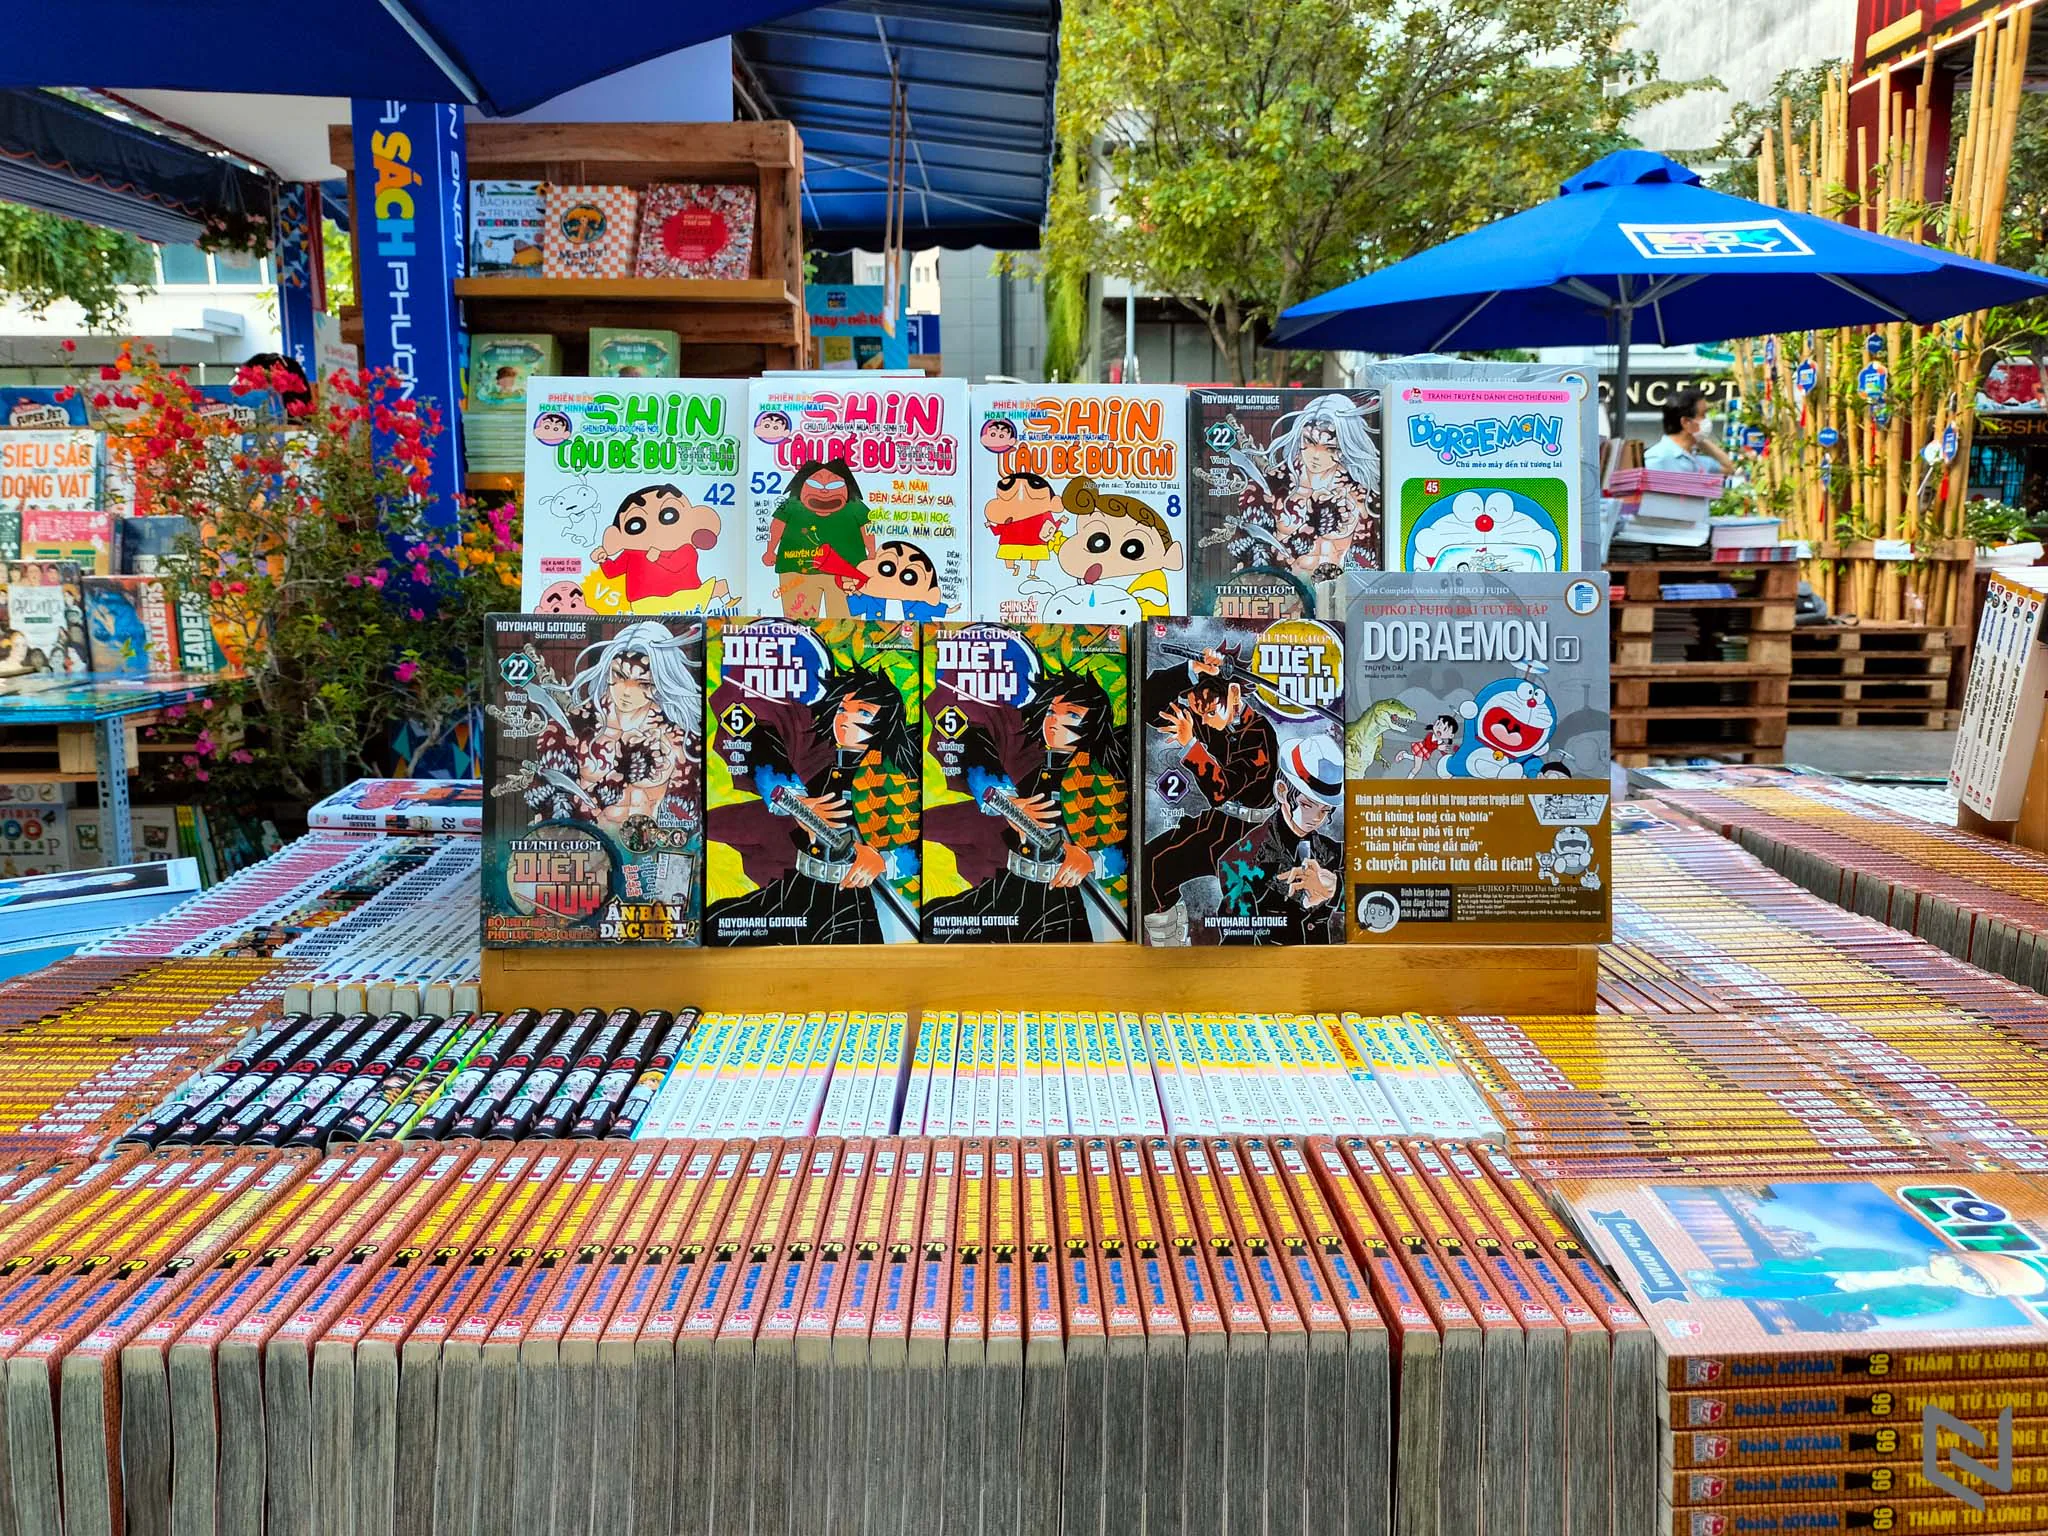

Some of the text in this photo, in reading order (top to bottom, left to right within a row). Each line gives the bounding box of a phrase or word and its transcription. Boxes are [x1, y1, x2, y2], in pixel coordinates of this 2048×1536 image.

[371, 130, 422, 256] SÁCH
[1428, 392, 1452, 400] TRANH
[1212, 427, 1231, 447] 22
[1086, 443, 1133, 475] BÚT
[1137, 443, 1174, 475] CHÌ
[750, 471, 782, 495] 52
[1124, 480, 1180, 490] Yoshito Usui
[1426, 481, 1439, 493] 45
[703, 483, 736, 506] 42
[1166, 494, 1182, 518] 8
[594, 583, 621, 607] VS
[1364, 604, 1407, 616] FUJIKO
[1410, 605, 1417, 615] F
[179, 591, 208, 672] EADERS
[496, 621, 587, 632] KOYOHARU GOTOUGE
[1363, 620, 1548, 661] DORAEMON
[508, 659, 529, 681] 22
[730, 709, 744, 731] 5
[944, 712, 957, 733] 5
[1167, 775, 1179, 797] 2
[1416, 811, 1438, 823] long
[510, 840, 558, 850] THANH
[1353, 857, 1362, 871] 3
[1365, 853, 1408, 873] chuyến
[1411, 856, 1446, 873] phiêu
[1450, 857, 1470, 871] lưu
[1473, 852, 1498, 871] đầu
[718, 916, 808, 929] KOYOHARU GOTOUGE
[933, 916, 1020, 928] KOYOHARU GOTOUGE
[1204, 916, 1288, 928] KOYOHARU GOTOUGE
[1223, 928, 1254, 936] Simirimi
[717, 1243, 739, 1253] 75
[858, 1242, 879, 1252] 76
[1174, 1238, 1195, 1248] 97
[398, 1249, 421, 1260] 73
[1030, 1245, 1052, 1255] 77
[5, 1256, 33, 1266] 70
[168, 1258, 194, 1268] 72
